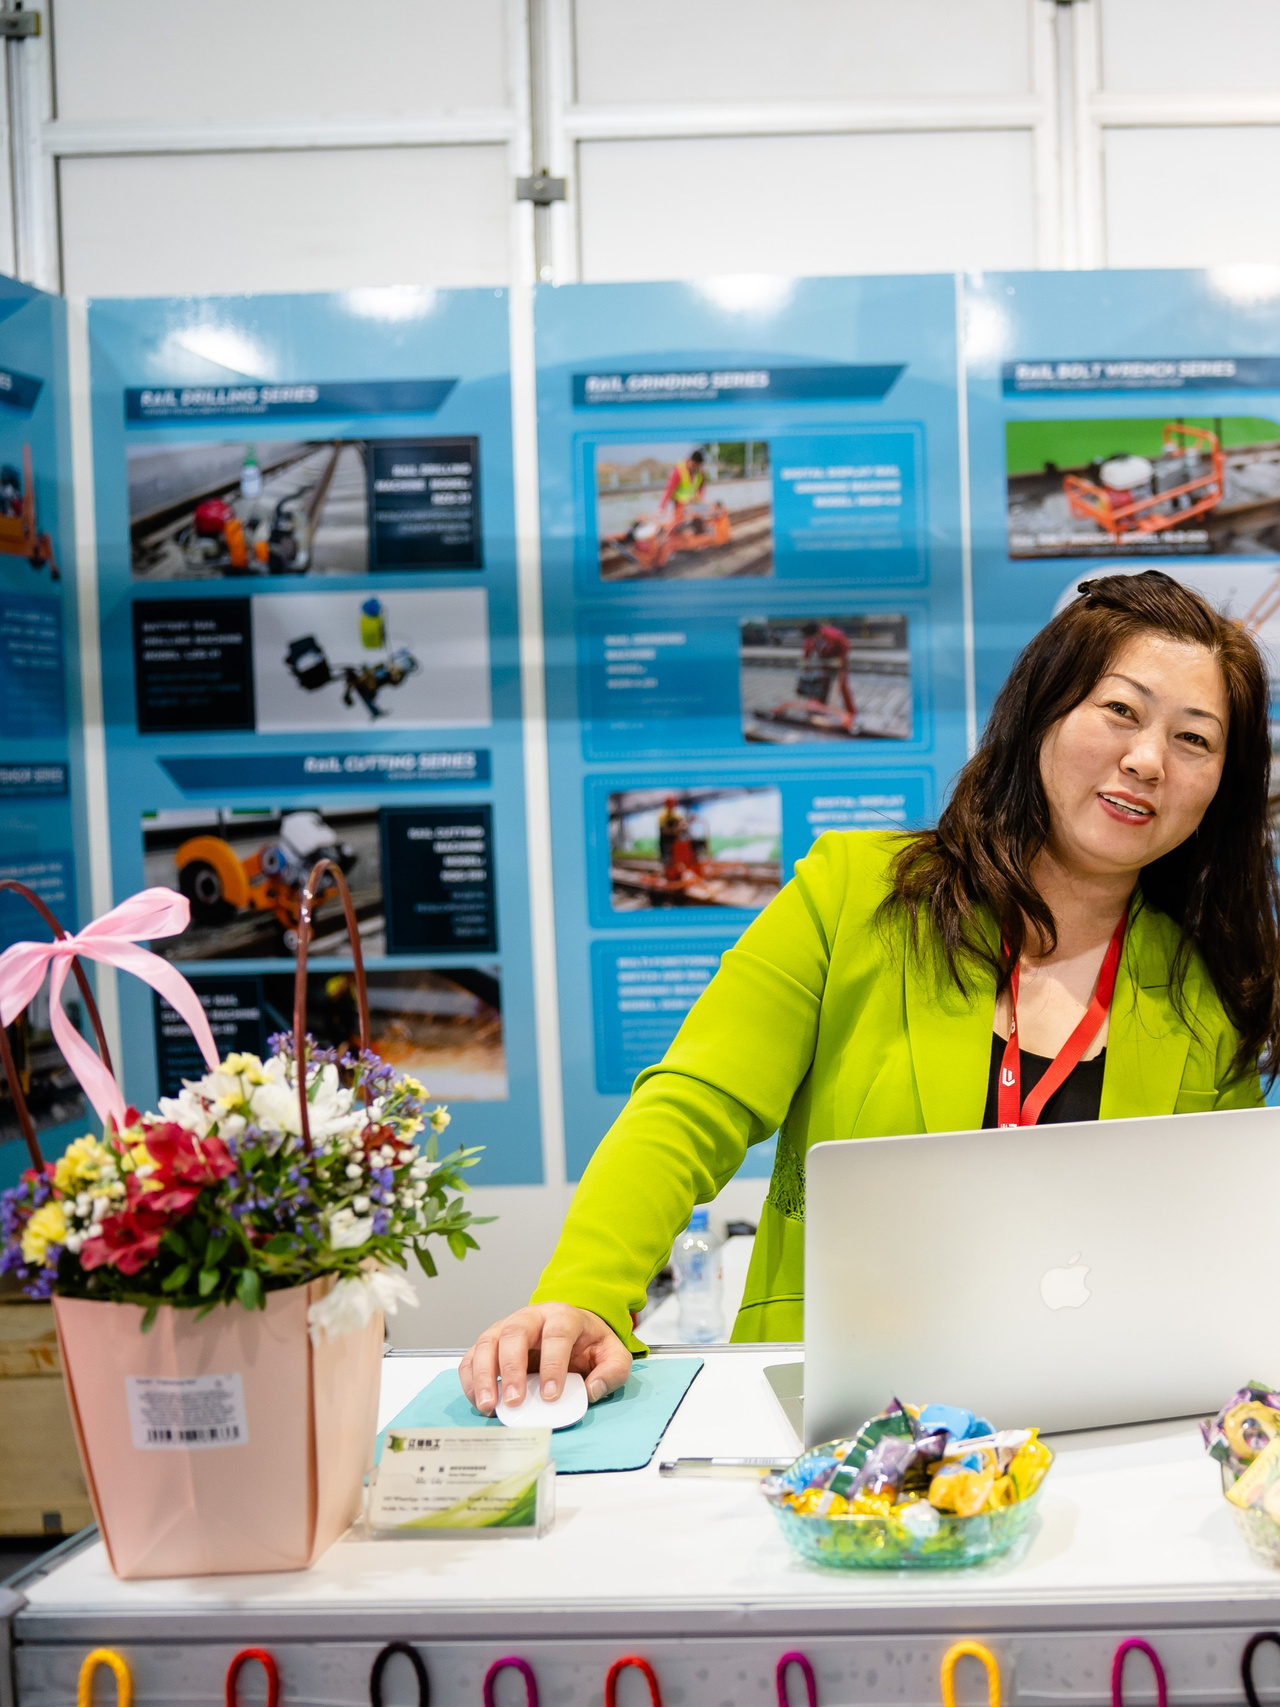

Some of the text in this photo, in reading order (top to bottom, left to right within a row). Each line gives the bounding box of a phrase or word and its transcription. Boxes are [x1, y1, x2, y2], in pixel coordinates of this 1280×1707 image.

[1104, 361, 1177, 378] WRENCH
[1178, 359, 1236, 377] SERIES
[710, 370, 770, 388] SERIES
[259, 384, 319, 403] SERIES
[417, 751, 477, 770] SERIES
